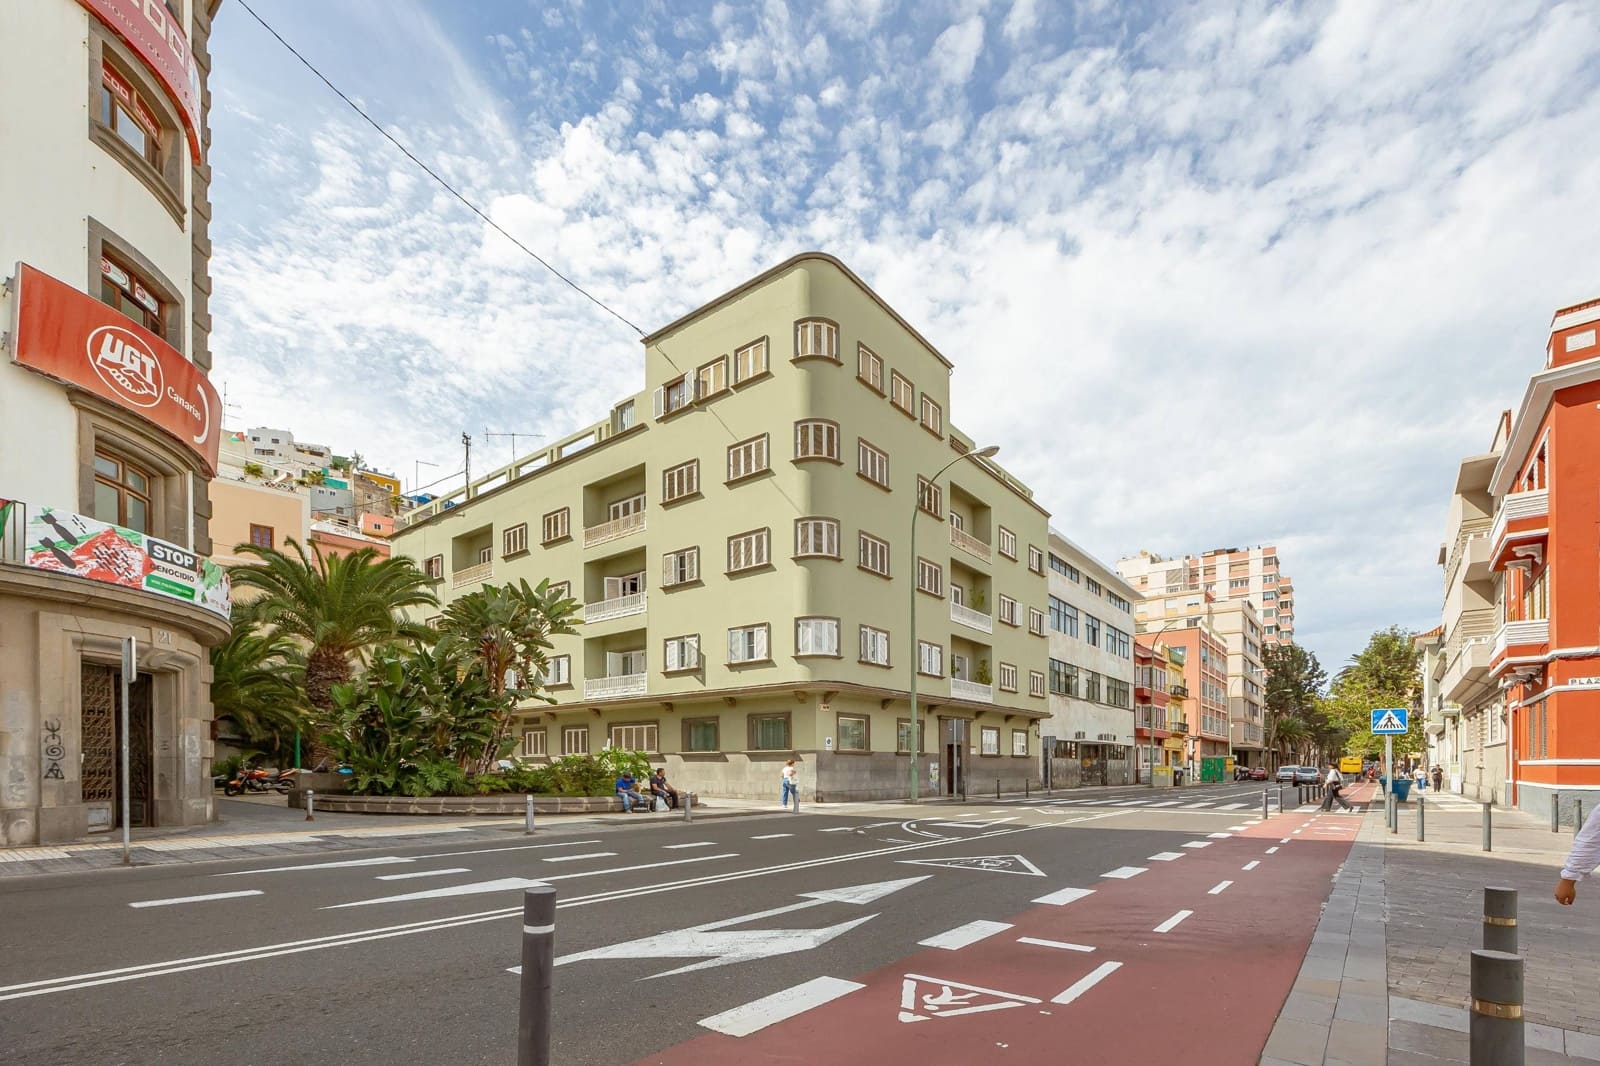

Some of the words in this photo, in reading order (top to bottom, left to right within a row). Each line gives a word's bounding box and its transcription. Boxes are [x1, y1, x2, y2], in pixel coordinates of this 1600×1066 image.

[100, 333, 156, 383] UGT
[167, 386, 201, 421] Canarias
[153, 545, 194, 567] STOP
